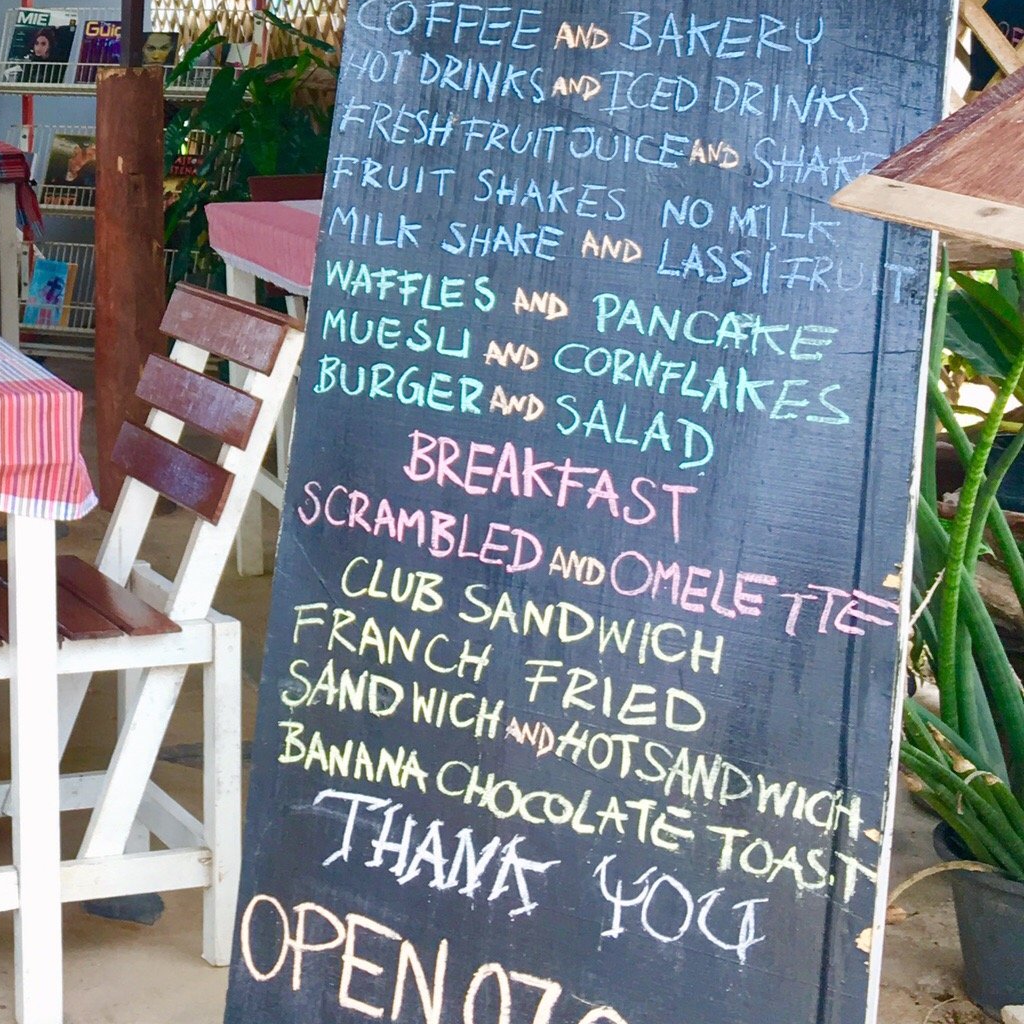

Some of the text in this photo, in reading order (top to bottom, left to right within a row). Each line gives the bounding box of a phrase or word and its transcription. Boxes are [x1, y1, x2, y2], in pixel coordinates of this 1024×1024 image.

[553, 21, 610, 51] AND
[619, 9, 824, 66] BAKERY
[339, 99, 453, 148] FRESH
[461, 117, 564, 162] FRUIT
[571, 127, 690, 170] JUICE
[689, 137, 740, 169] AND
[343, 49, 869, 134] HOT DRINKS AND ICED DRINKS
[331, 154, 841, 248] FRUIT SHAKES NO MILK
[328, 205, 423, 250] MILK
[441, 222, 565, 262] SHAKE
[581, 230, 643, 264] AND
[779, 255, 916, 304] FRUIT
[326, 260, 839, 363] WAFFLES AND PANCAKE
[314, 355, 714, 471] BURGER AND SALAD
[484, 338, 539, 372] AND
[555, 342, 851, 427] CORNFLAKES
[297, 480, 543, 575] SCRAMBLED
[549, 546, 606, 589] AND
[404, 429, 698, 544] BREAKFAST
[292, 602, 707, 733] FRANCH FRIED
[341, 556, 726, 675] CLUB SANDWICH
[280, 658, 506, 740] SANDWICH
[506, 718, 554, 759] AND
[278, 720, 880, 906] BANANA CHOCOLATE TOAST
[313, 788, 771, 967] THANK YOU
[240, 894, 448, 1022] OPEN
